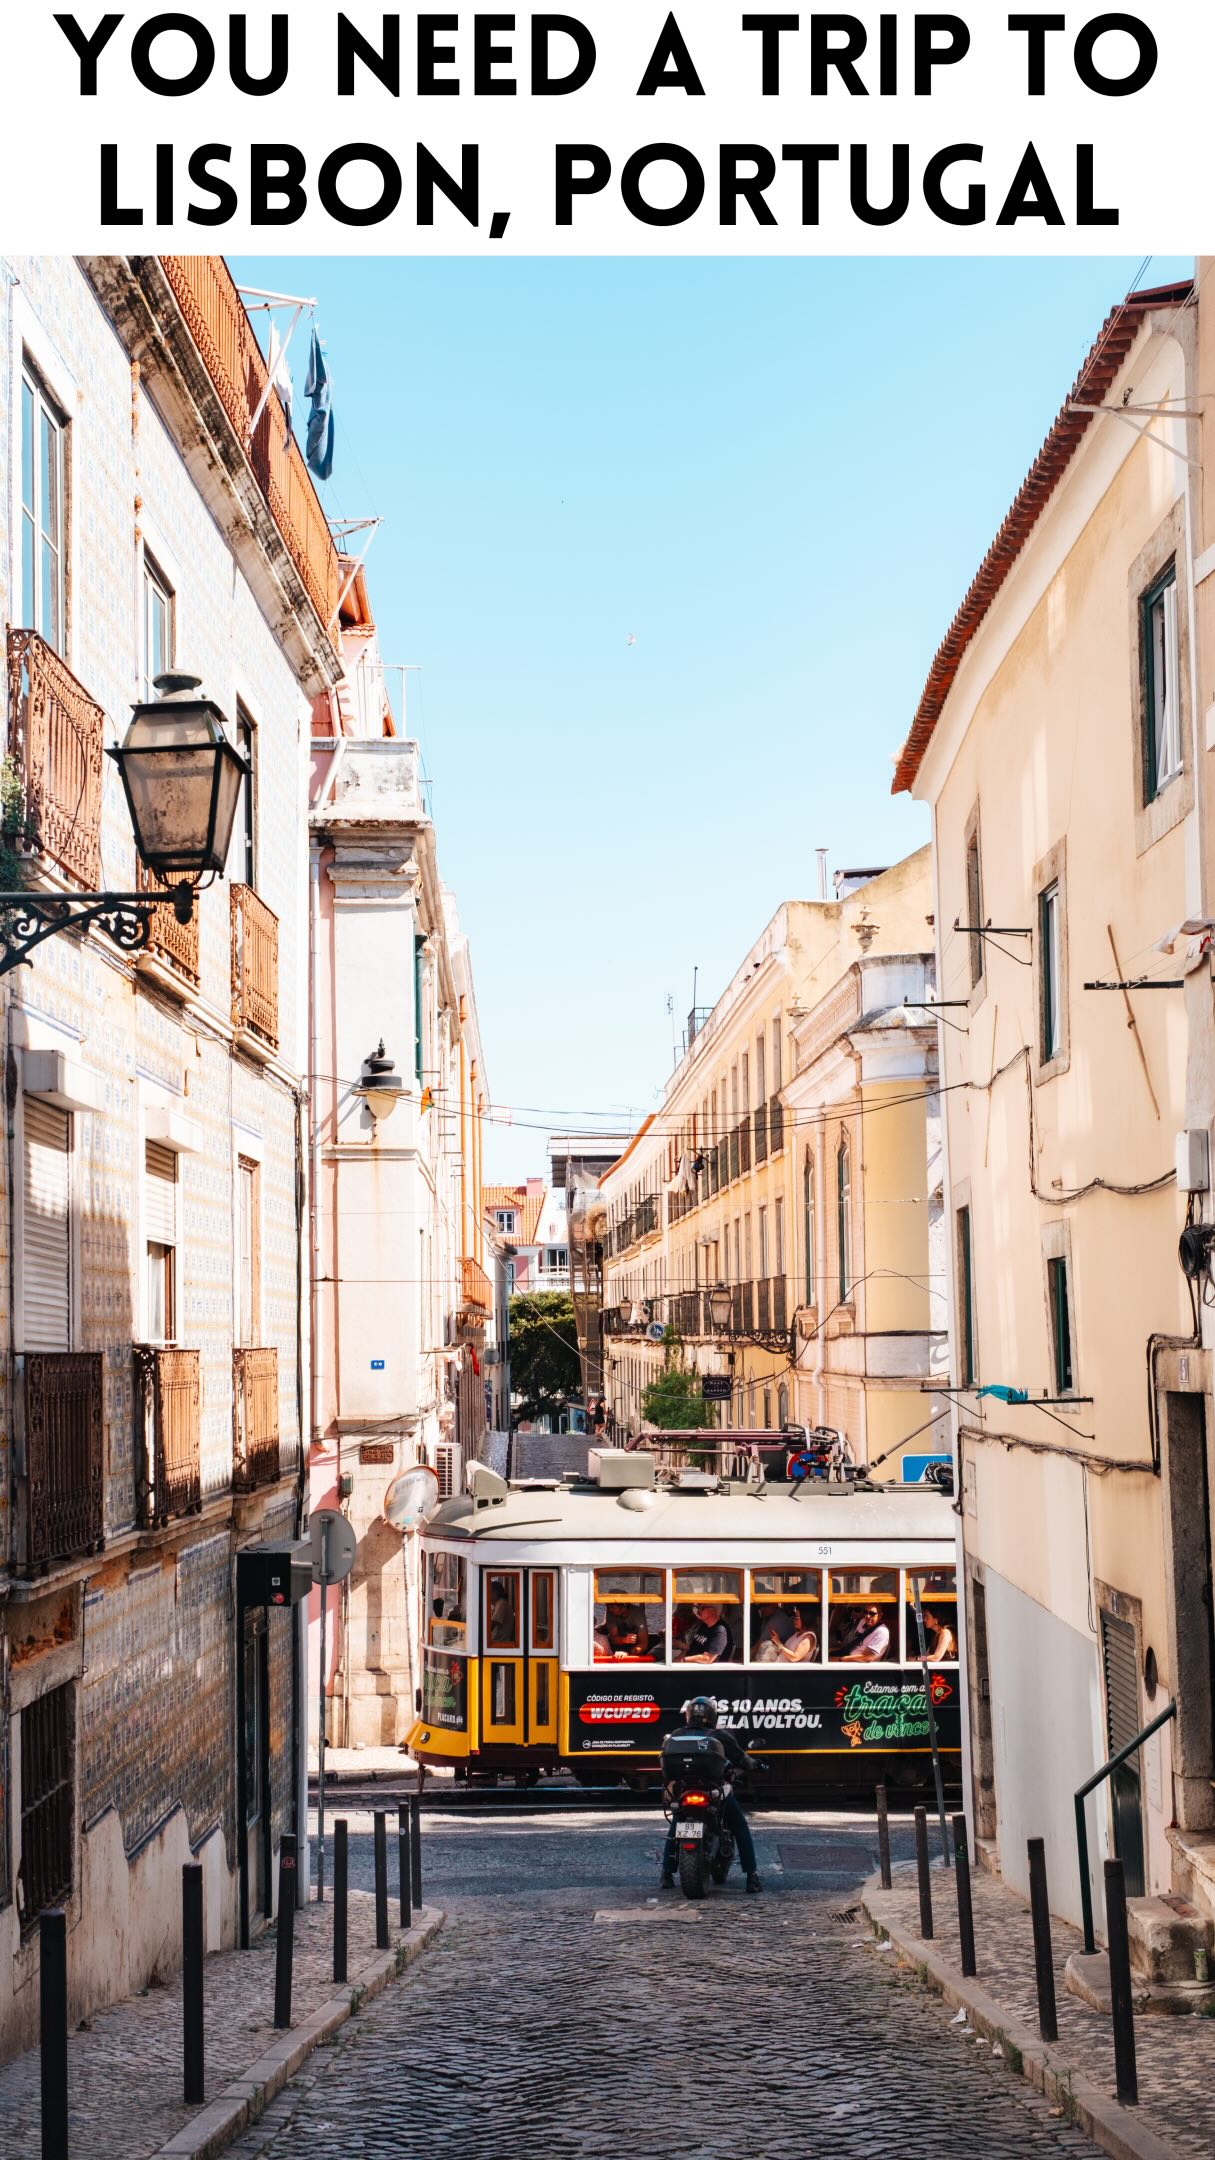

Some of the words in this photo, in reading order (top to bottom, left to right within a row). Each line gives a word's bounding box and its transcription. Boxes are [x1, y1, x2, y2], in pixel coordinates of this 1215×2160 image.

[818, 1546, 832, 1555] 551
[901, 1685, 918, 1693] com
[586, 1694, 613, 1702] CÓDIGO
[731, 1699, 751, 1713] 10
[752, 1699, 804, 1713] ANOS,
[591, 1708, 651, 1719] WCUP20
[716, 1715, 750, 1729] ELA
[752, 1715, 823, 1729] VOLTOU.
[863, 1720, 884, 1740] de
[677, 1830, 688, 1838] XZ
[692, 1830, 701, 1838] 76
